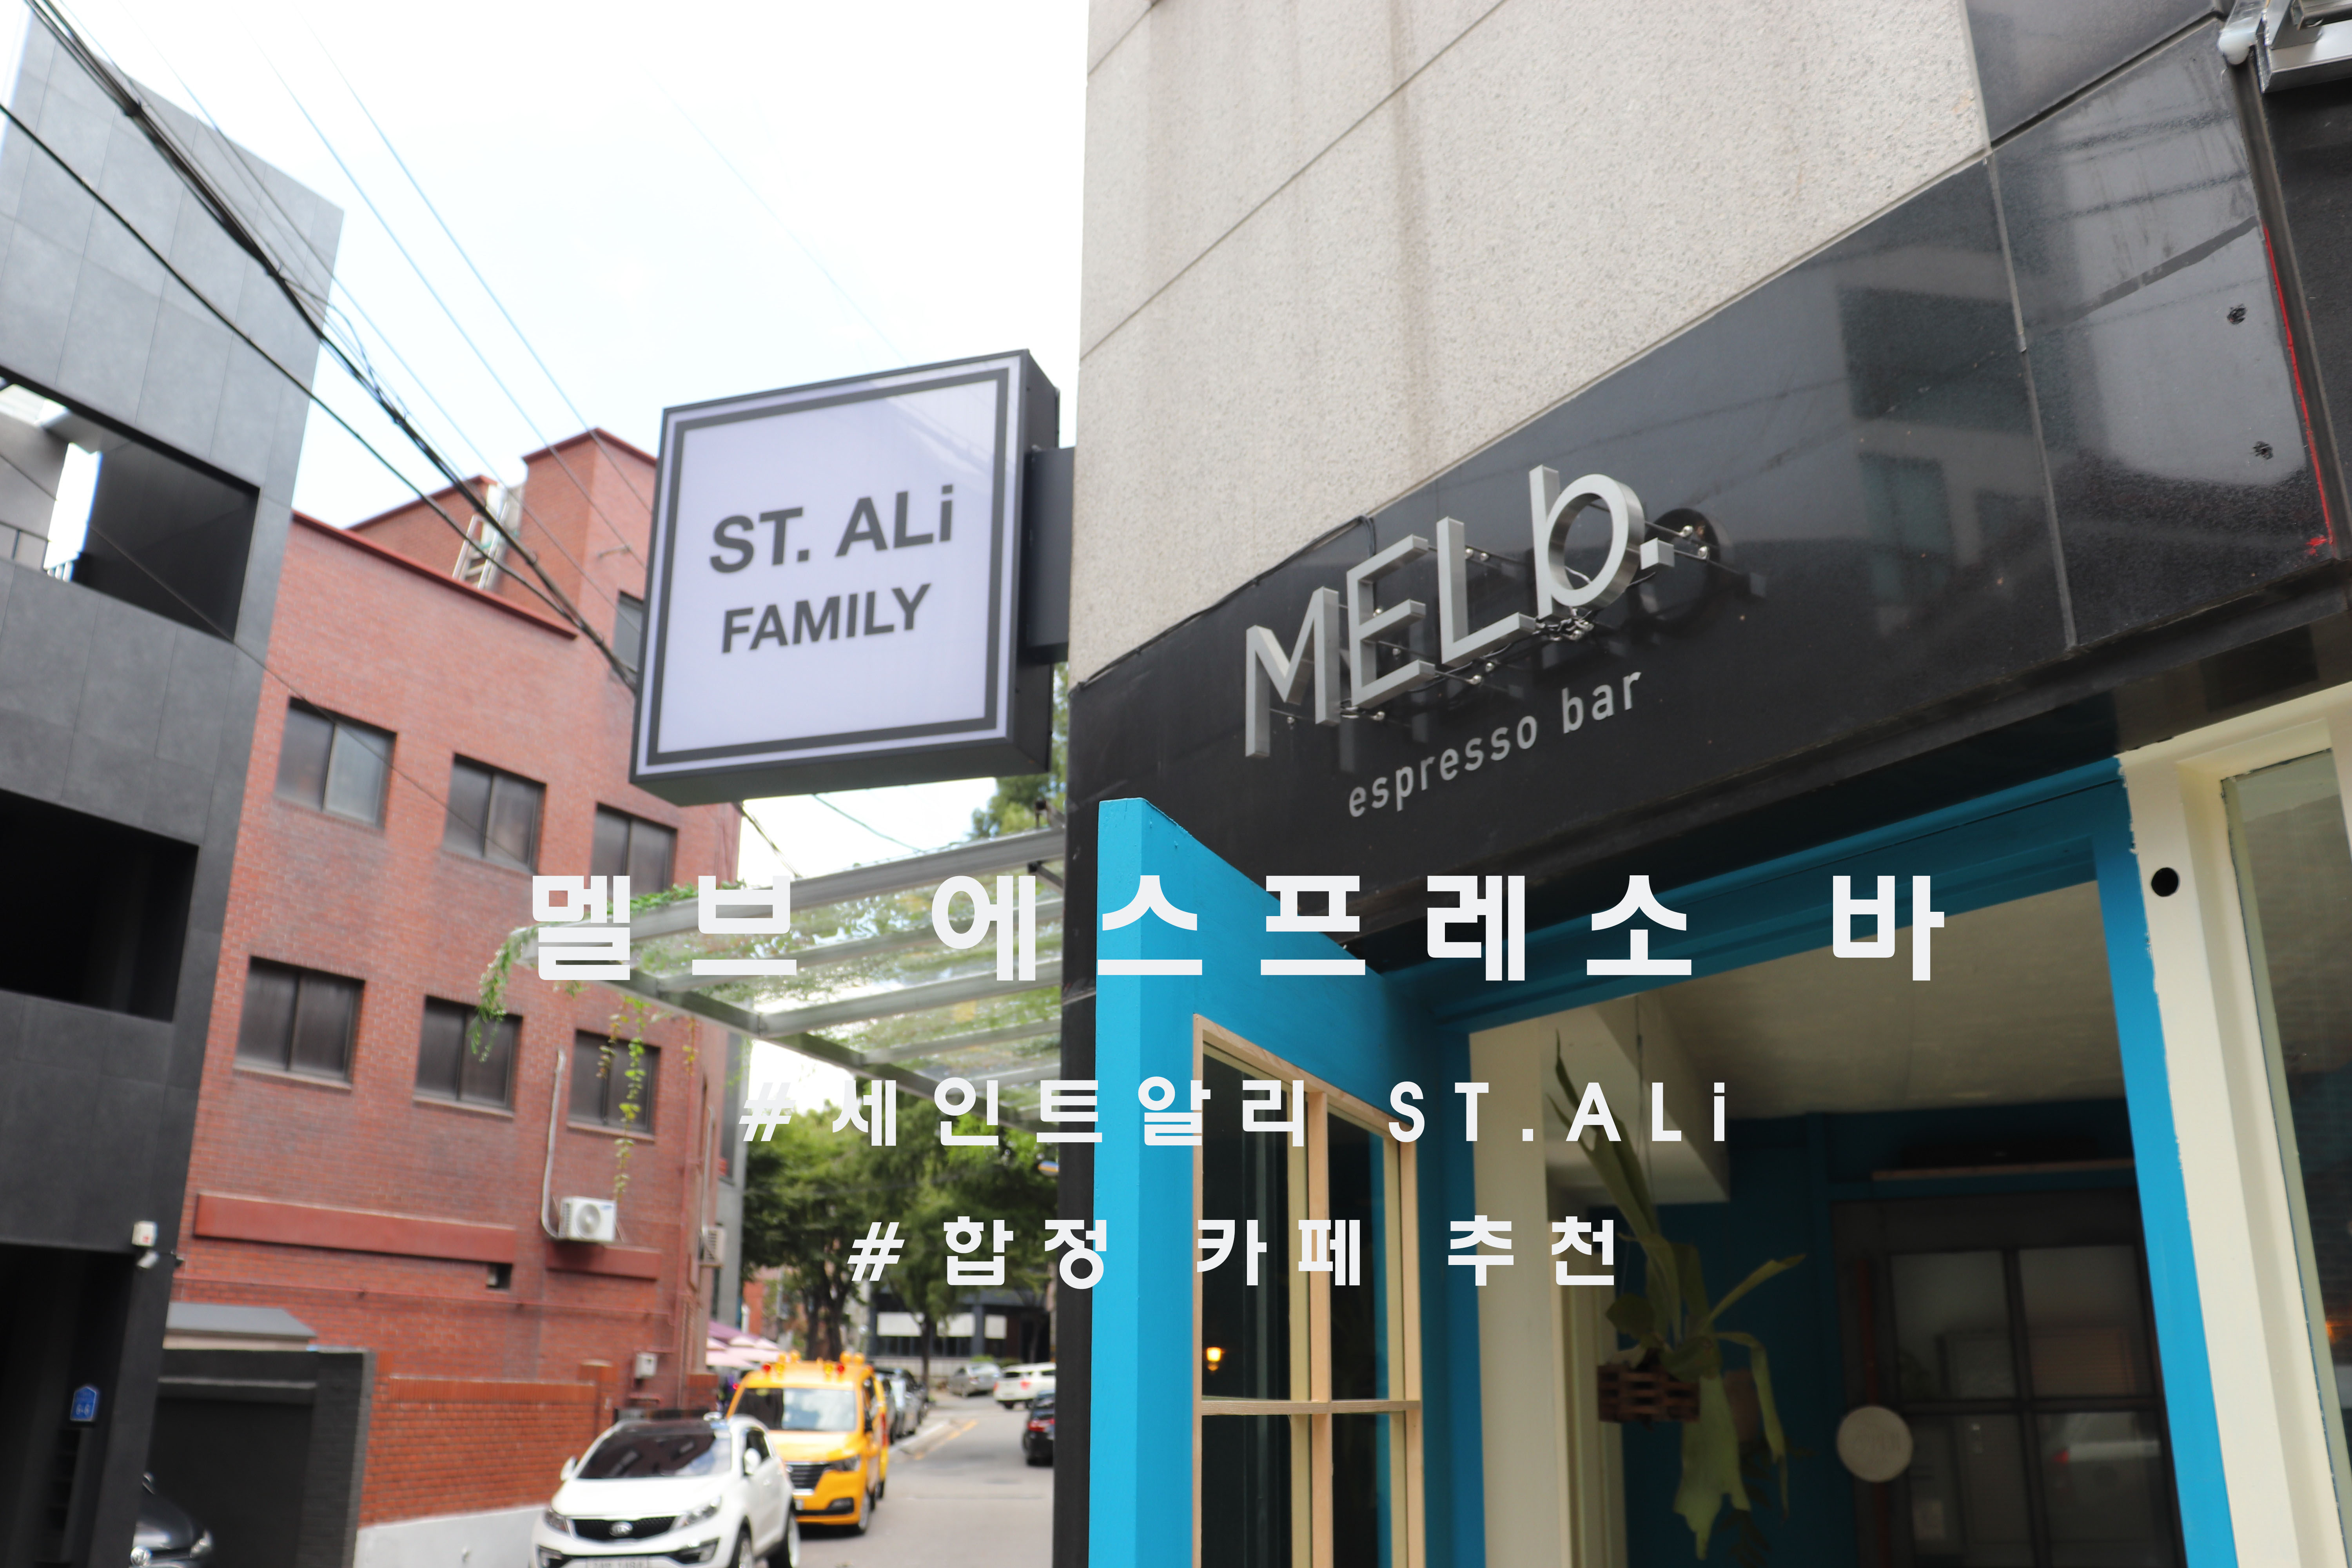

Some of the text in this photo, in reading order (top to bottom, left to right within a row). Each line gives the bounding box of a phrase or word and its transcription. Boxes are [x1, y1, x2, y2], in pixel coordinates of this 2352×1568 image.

[710, 484, 953, 573] ST. ALi
[722, 583, 931, 653] FAMILY
[1348, 671, 1642, 817] espresso bar
